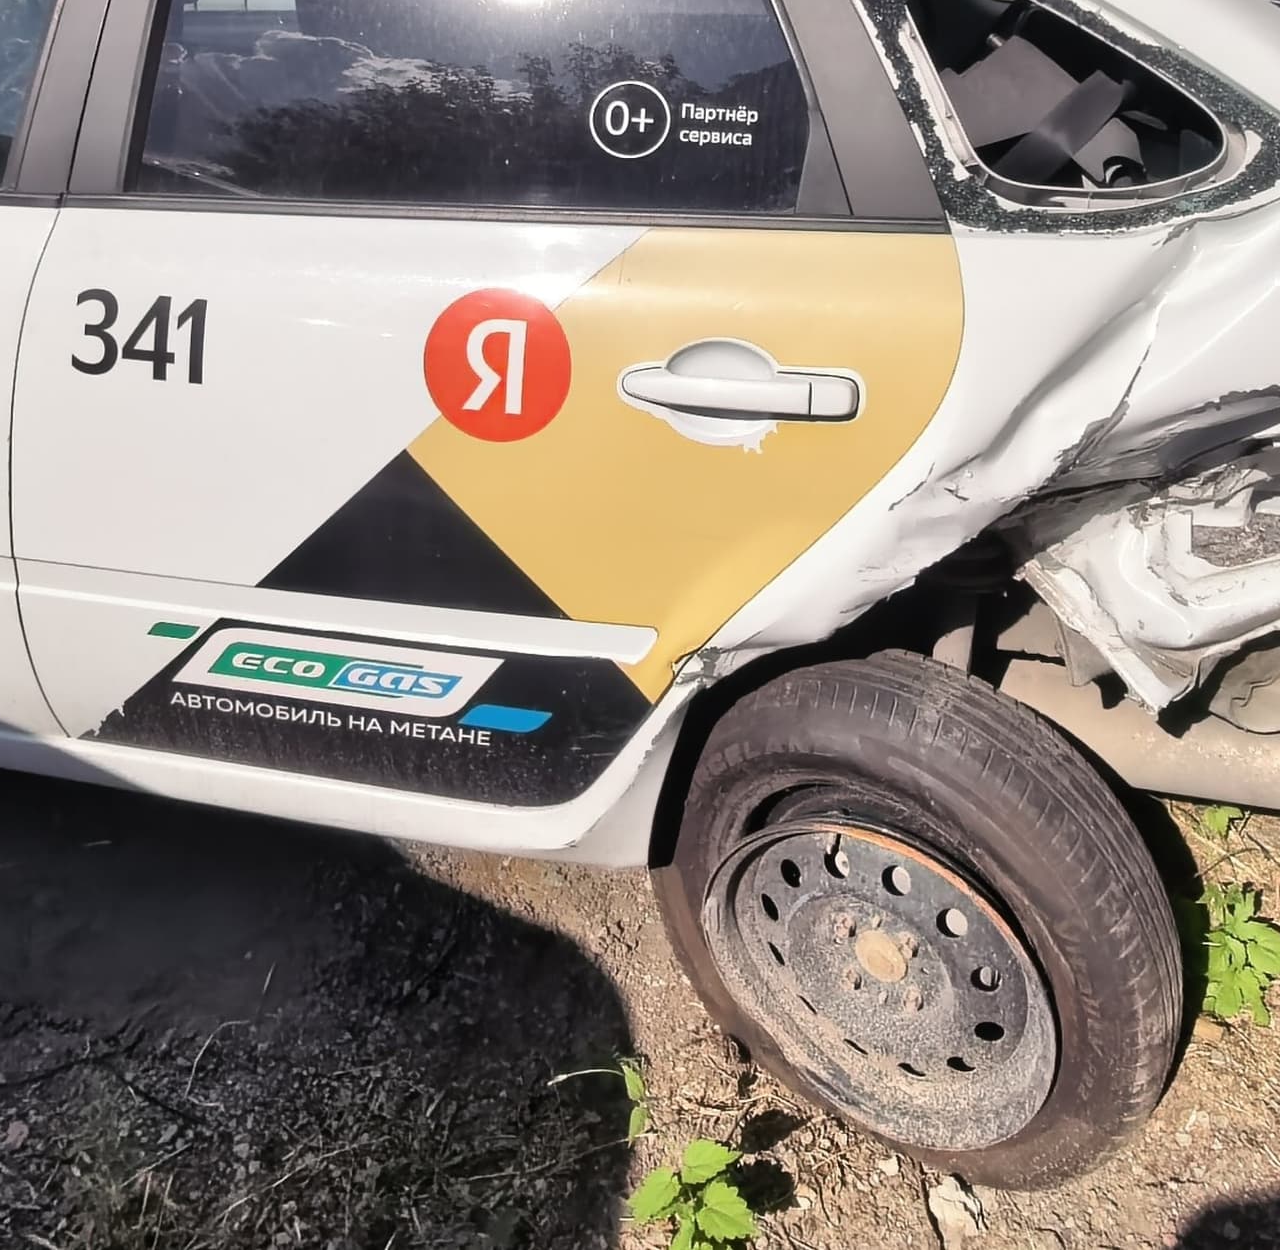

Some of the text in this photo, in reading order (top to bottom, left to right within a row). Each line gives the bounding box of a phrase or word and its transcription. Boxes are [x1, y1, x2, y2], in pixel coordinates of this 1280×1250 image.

[605, 100, 655, 136] 0+
[681, 102, 759, 126] Партнёр
[679, 129, 753, 147] сервиса
[71, 288, 208, 385] 341
[462, 318, 528, 415] Я
[231, 651, 326, 679] ECO
[170, 691, 492, 747] АВТОМОБИЛЬ НА МЕТАНЕ
